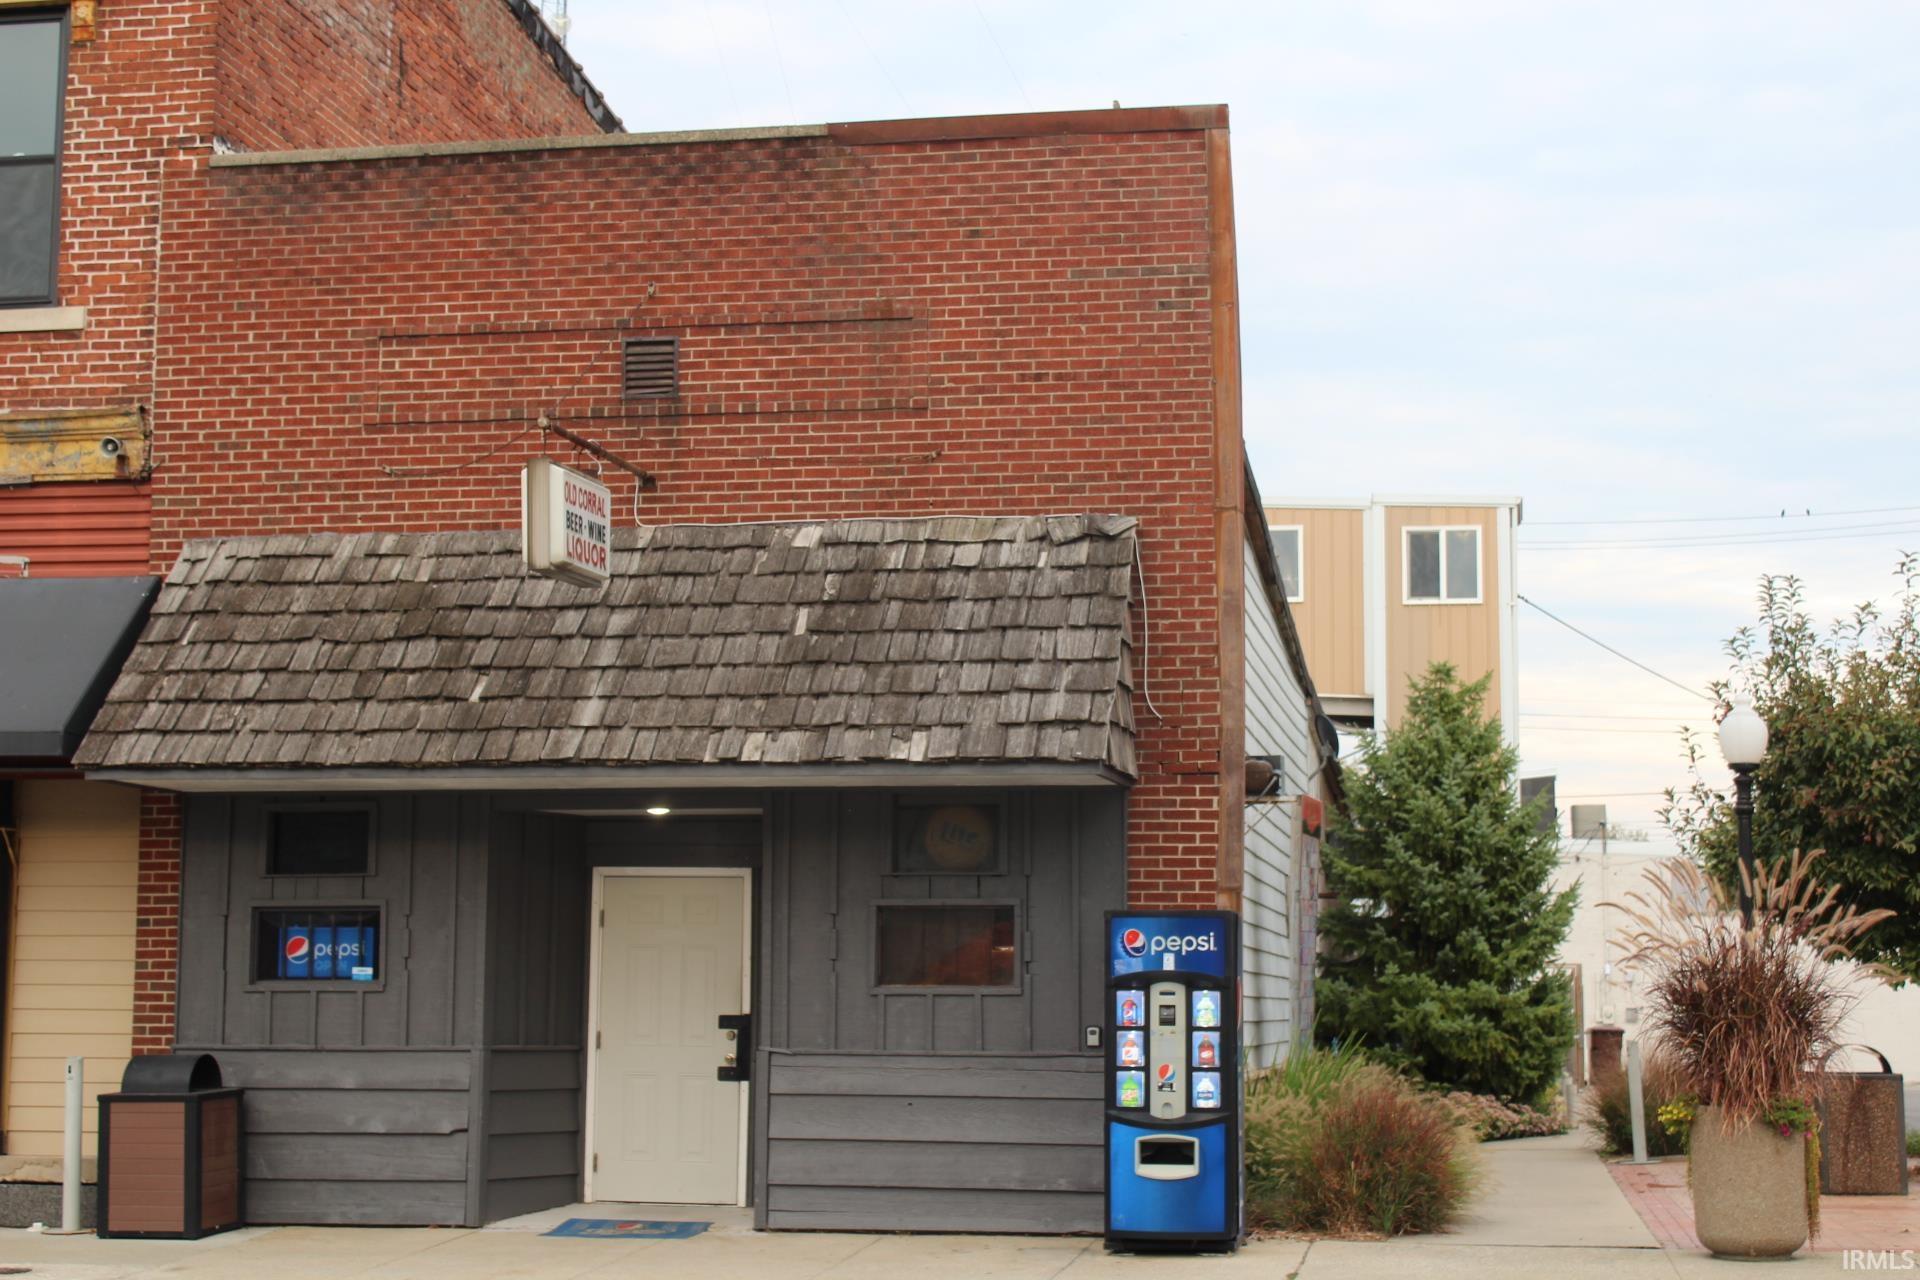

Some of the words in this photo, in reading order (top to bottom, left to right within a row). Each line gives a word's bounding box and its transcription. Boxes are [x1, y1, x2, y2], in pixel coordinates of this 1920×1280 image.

[564, 481, 577, 506] OLD
[578, 487, 606, 518] CORRAL
[566, 509, 582, 535] BEER
[587, 519, 606, 543] WINE
[566, 532, 606, 571] LIQUOR
[1151, 932, 1215, 956] pepsi
